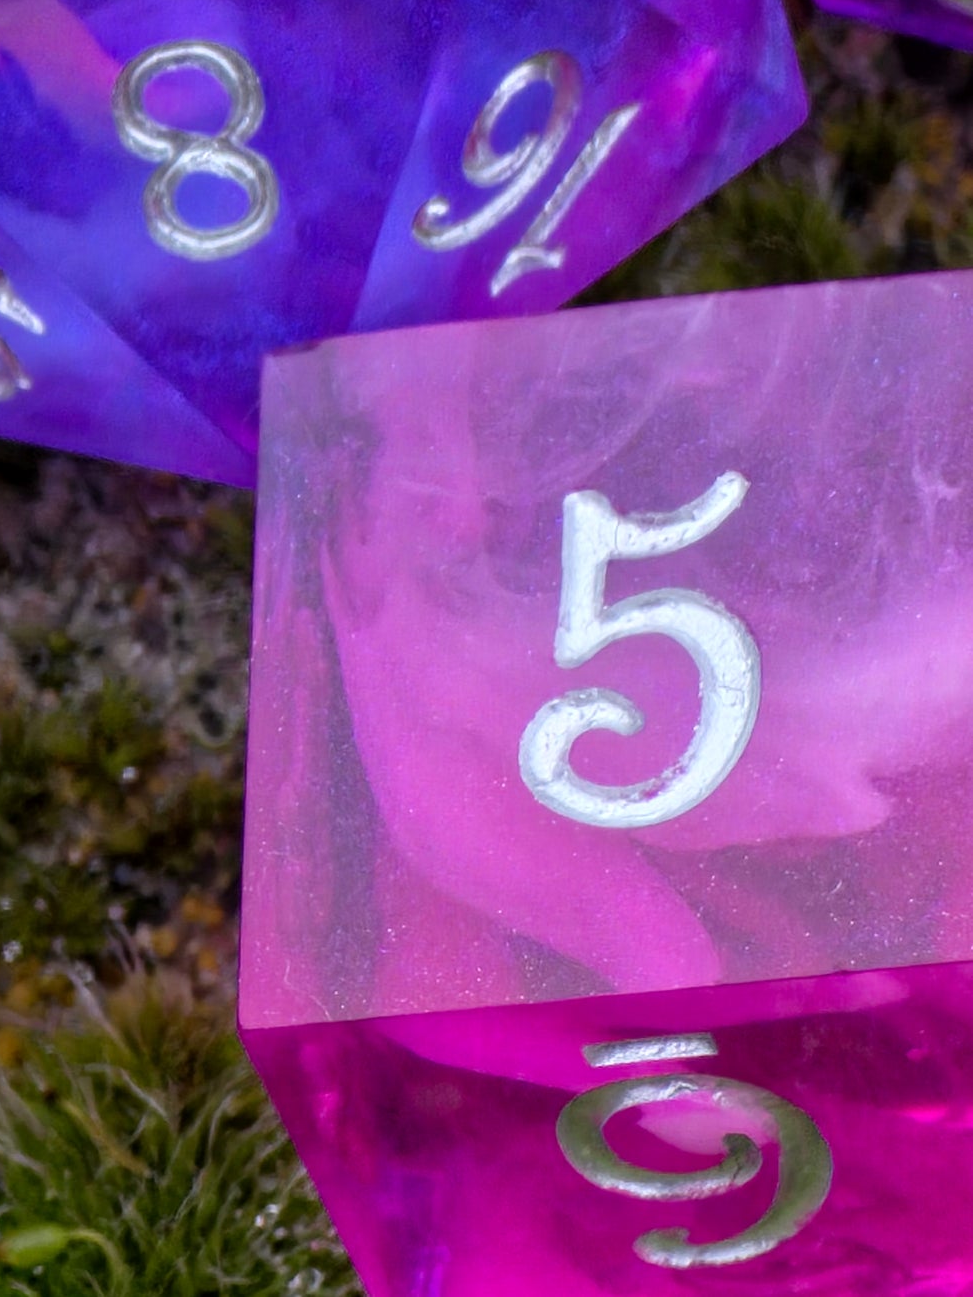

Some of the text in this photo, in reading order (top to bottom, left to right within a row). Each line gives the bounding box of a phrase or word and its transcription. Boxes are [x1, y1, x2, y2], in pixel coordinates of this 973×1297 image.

[112, 39, 279, 262] 8
[412, 49, 641, 298] 16
[517, 470, 762, 829] 5
